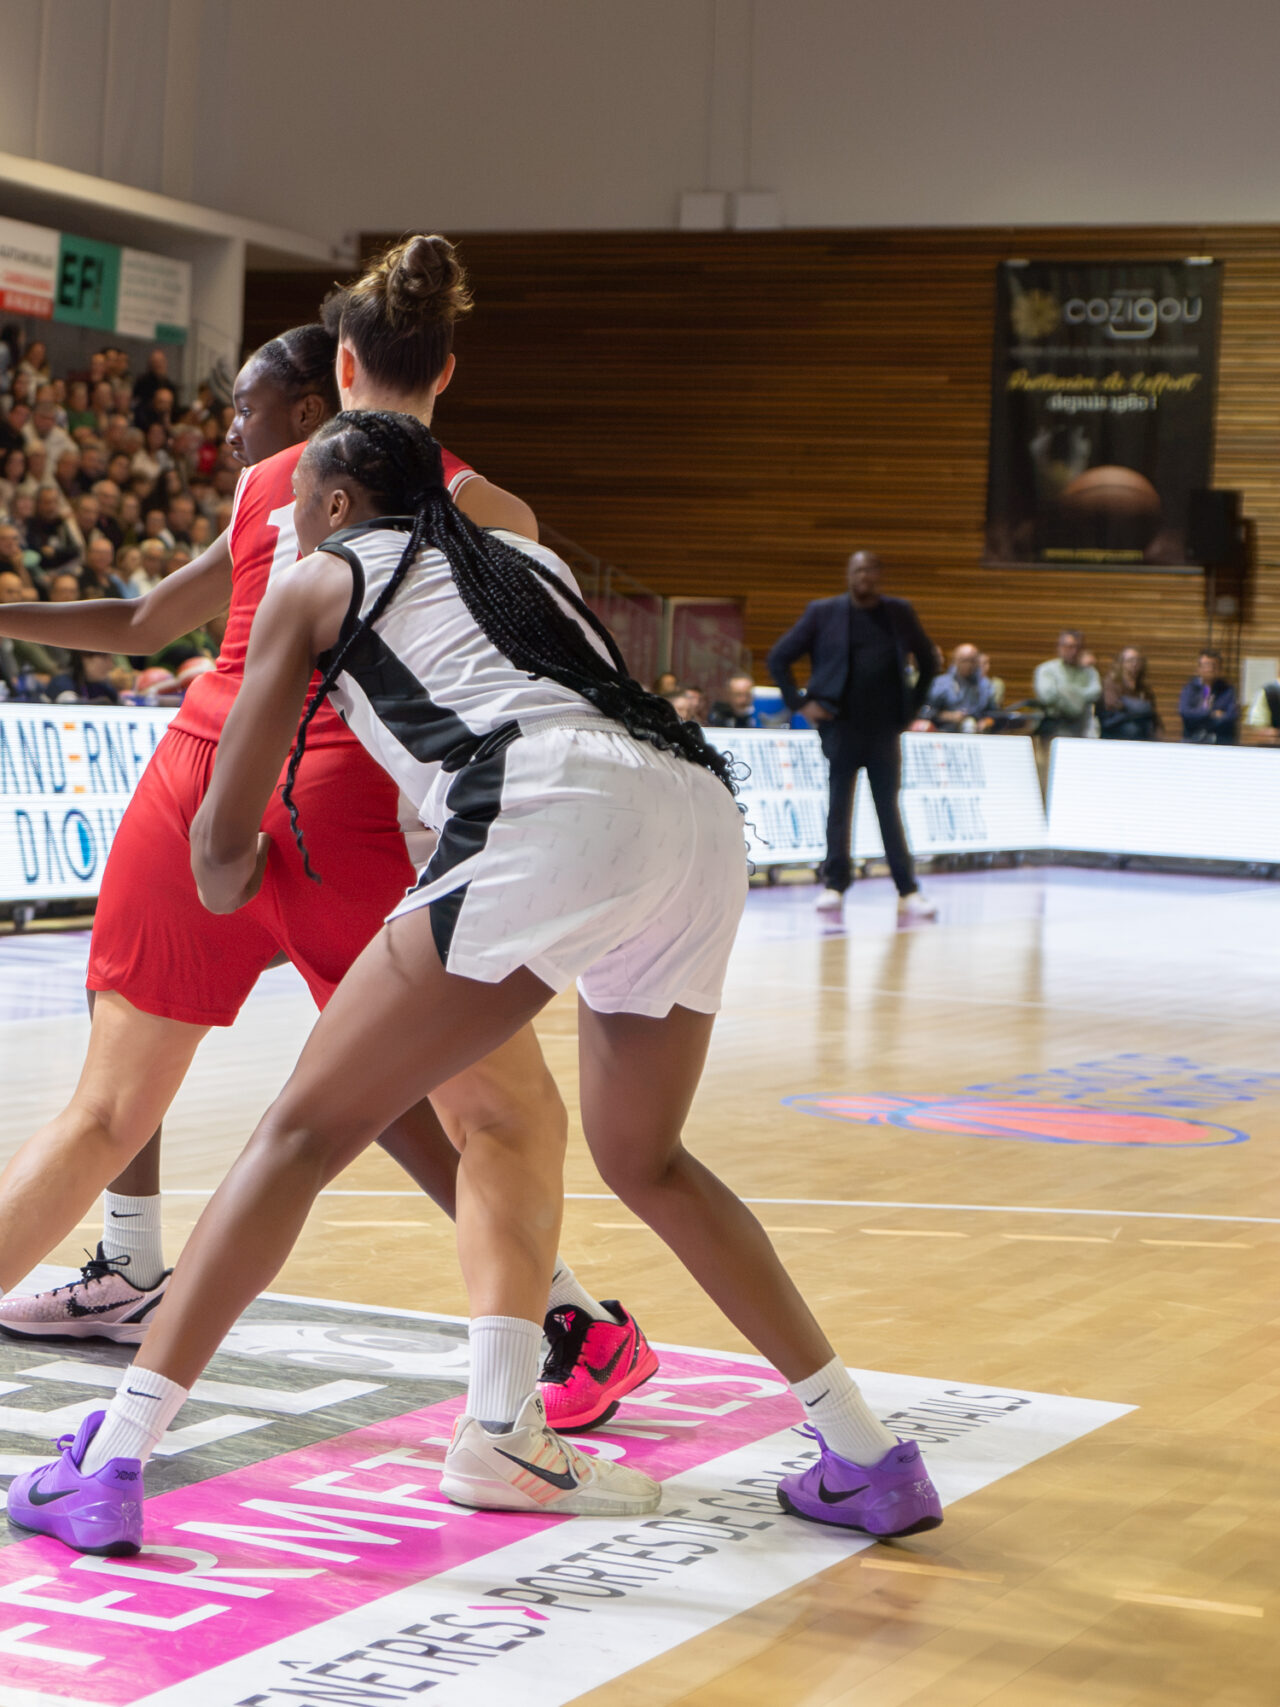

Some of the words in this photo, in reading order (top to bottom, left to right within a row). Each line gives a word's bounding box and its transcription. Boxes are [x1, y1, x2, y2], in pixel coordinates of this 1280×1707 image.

[1064, 296, 1204, 340] cozigou
[482, 1534, 719, 1612] PORTES
[640, 1508, 775, 1542] DE
